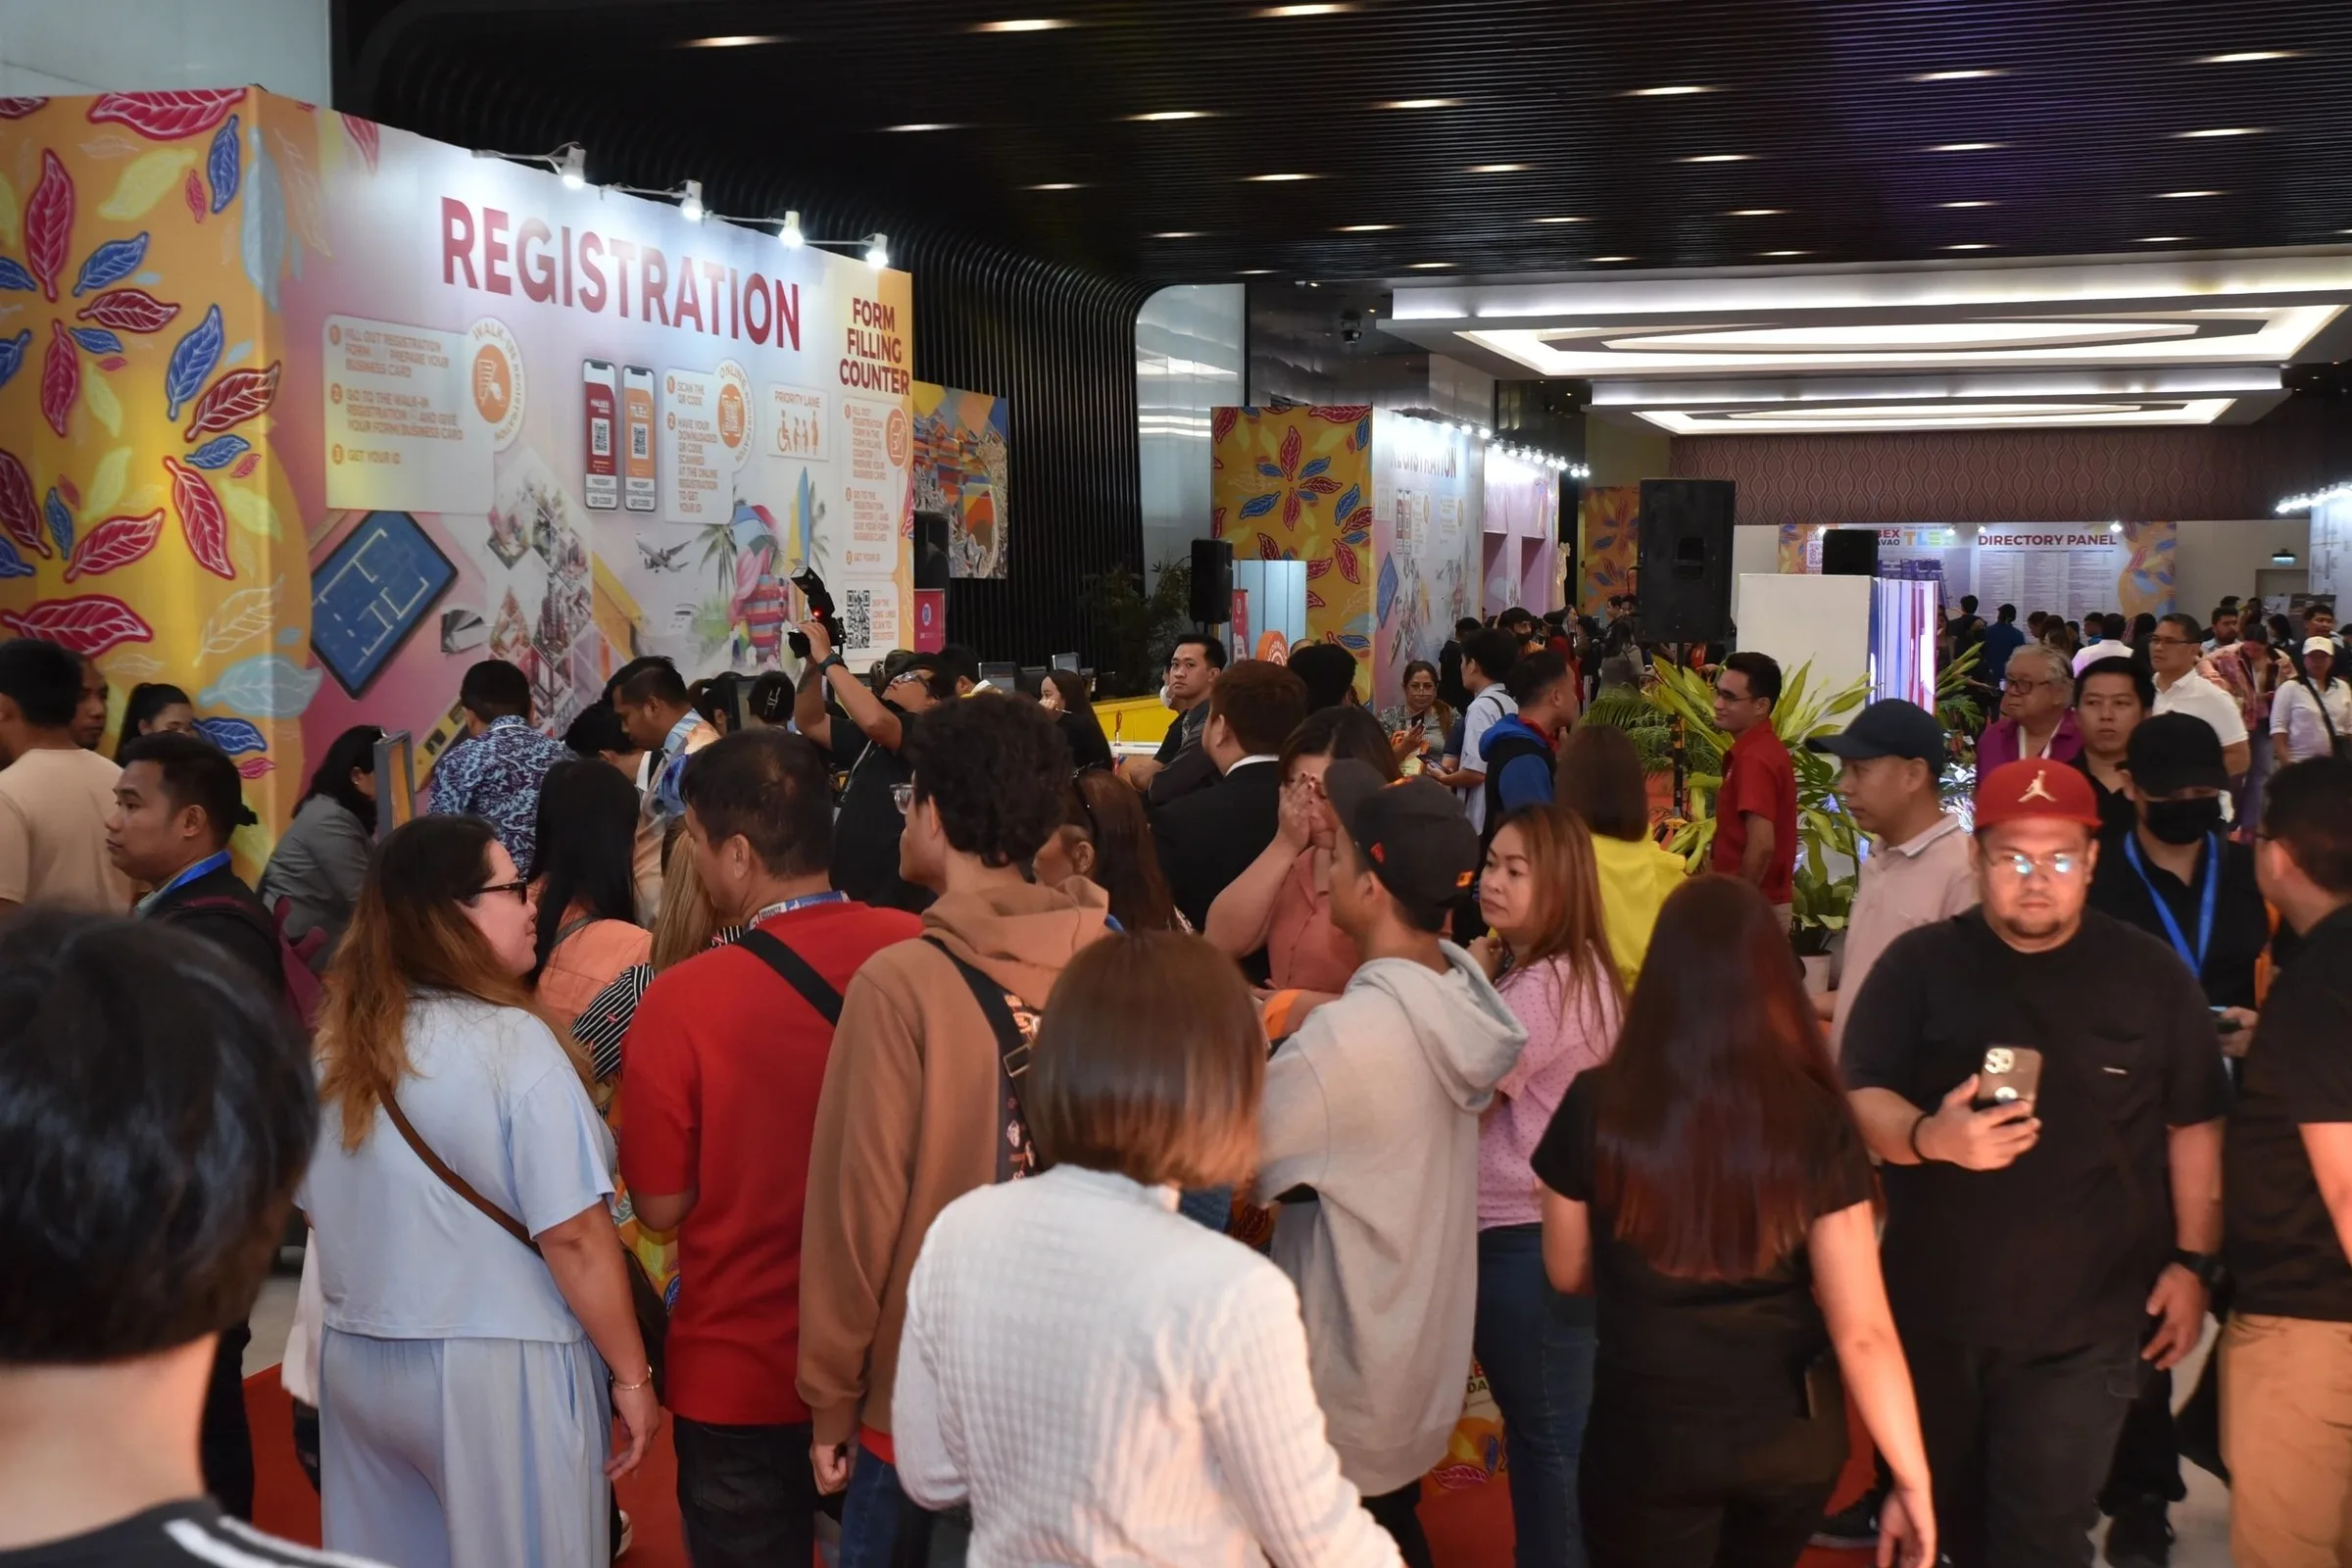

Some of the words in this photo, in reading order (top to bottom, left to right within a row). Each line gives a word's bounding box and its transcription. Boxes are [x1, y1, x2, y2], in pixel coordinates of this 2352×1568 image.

[441, 196, 800, 351] REGISTRATION
[853, 297, 895, 332] FORM
[364, 331, 381, 344] OUT
[383, 333, 441, 351] REGISTRATION
[847, 327, 902, 364] FILLING
[345, 344, 370, 356] FORM
[389, 349, 425, 365] PREPARE
[427, 355, 450, 368] YOUR
[346, 358, 386, 374] BUSINESS
[388, 364, 412, 378] CARD
[839, 359, 910, 396] COUNTER
[677, 381, 694, 393] SCAN
[695, 383, 705, 395] THE
[346, 389, 360, 402] GO
[362, 390, 374, 403] TO
[376, 392, 392, 405] THE
[677, 396, 686, 405] QR
[687, 397, 703, 407] CODE
[774, 390, 803, 405] PRIORITY
[804, 395, 820, 409] LANE
[346, 404, 407, 420] REGISTRATION
[419, 411, 436, 423] AND
[439, 413, 457, 425] GIVE
[347, 419, 370, 432] YOUR
[441, 428, 464, 441] CARD
[695, 420, 710, 431] YOUR
[348, 449, 365, 462] GET
[367, 451, 390, 464] YOUR
[393, 453, 401, 465] ID
[687, 444, 704, 454] CODE
[687, 467, 698, 477] THE
[699, 468, 718, 479] ONLINE
[678, 478, 718, 490] REGISTRATION
[688, 491, 699, 501] GET
[679, 503, 694, 513] YOUR
[1978, 535, 2063, 546] DIRECTORY
[2067, 534, 2118, 546] PANEL
